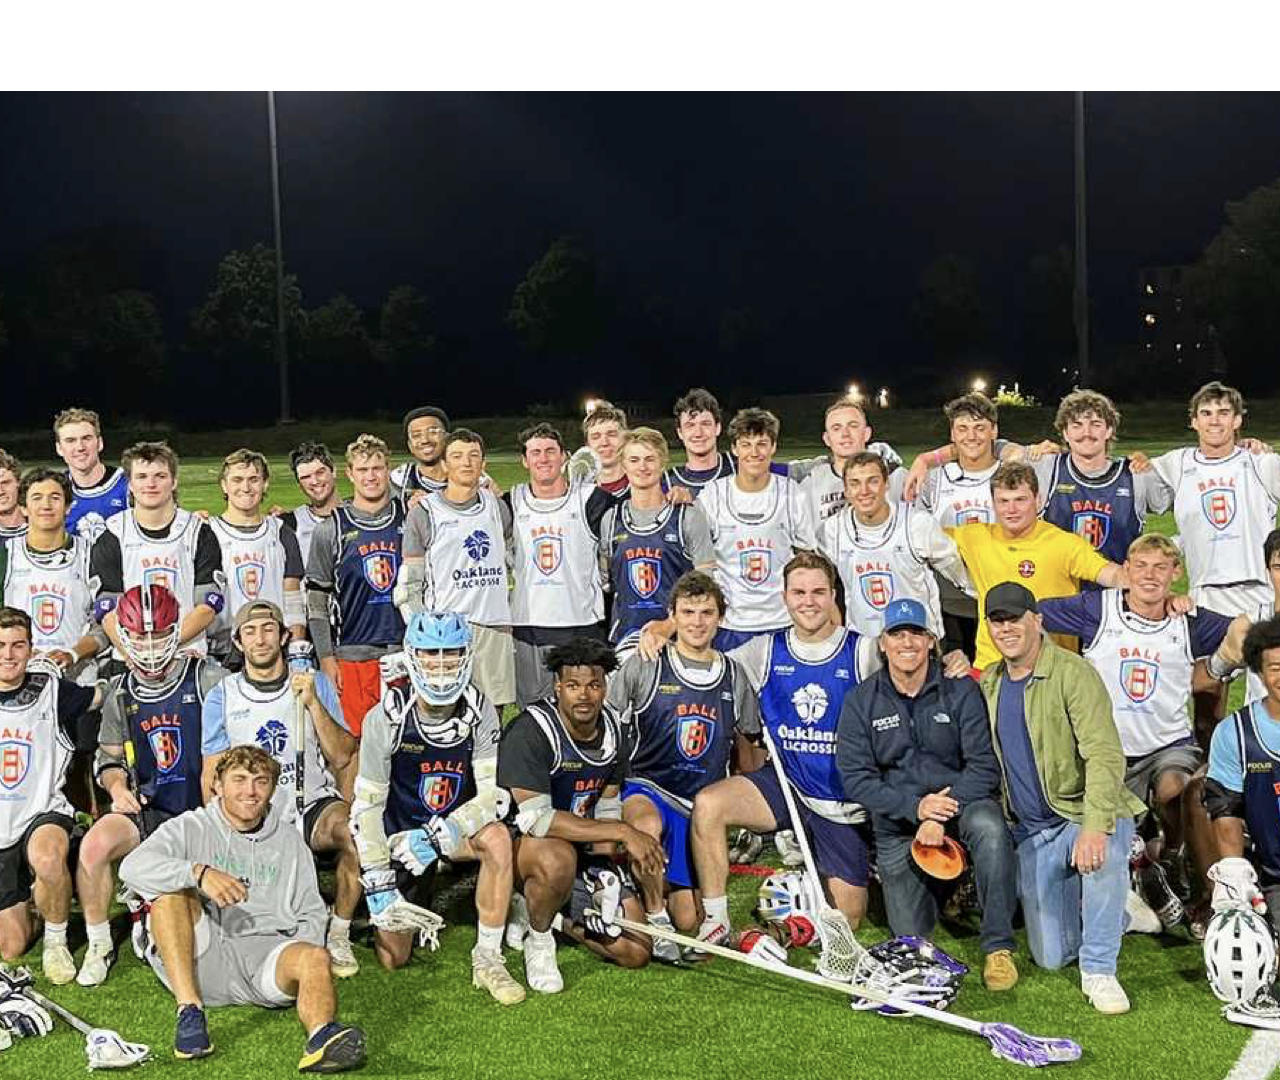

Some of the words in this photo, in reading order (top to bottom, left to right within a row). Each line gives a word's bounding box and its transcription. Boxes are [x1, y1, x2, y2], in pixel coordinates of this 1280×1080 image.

[1197, 476, 1238, 491] BALL
[953, 499, 992, 511] BALL
[1072, 500, 1112, 514] BALL
[357, 541, 396, 554] BALL
[736, 537, 774, 550] BALL
[232, 551, 267, 564] BALL
[624, 547, 663, 560] BALL
[140, 556, 180, 569] BALL
[855, 561, 891, 573] BALL
[28, 583, 68, 597] BALL
[1119, 647, 1162, 661] BALL
[676, 703, 718, 719] BALL
[139, 714, 182, 731] BALL
[420, 760, 464, 774] BALL
